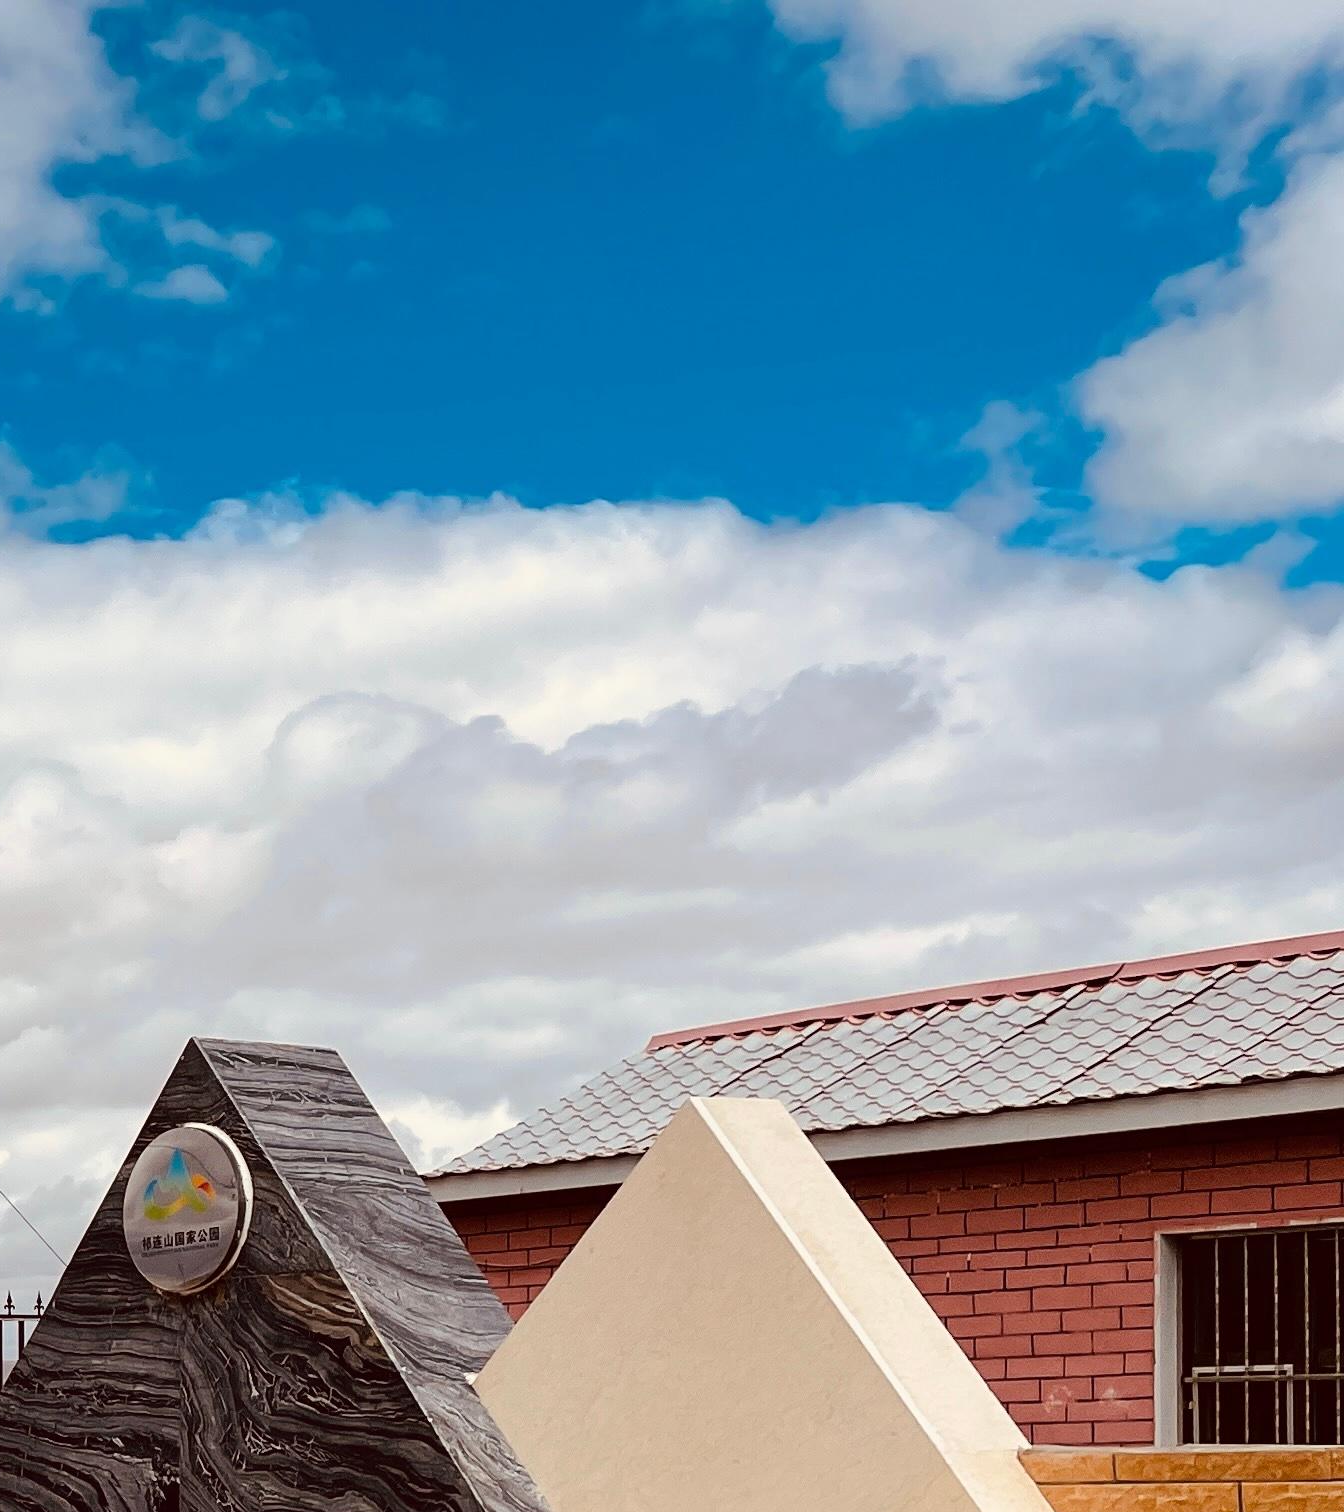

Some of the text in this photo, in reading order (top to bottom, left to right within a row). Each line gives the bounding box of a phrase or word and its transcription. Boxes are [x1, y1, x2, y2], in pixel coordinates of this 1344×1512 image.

[142, 1226, 220, 1251] 祁连山国家公园
